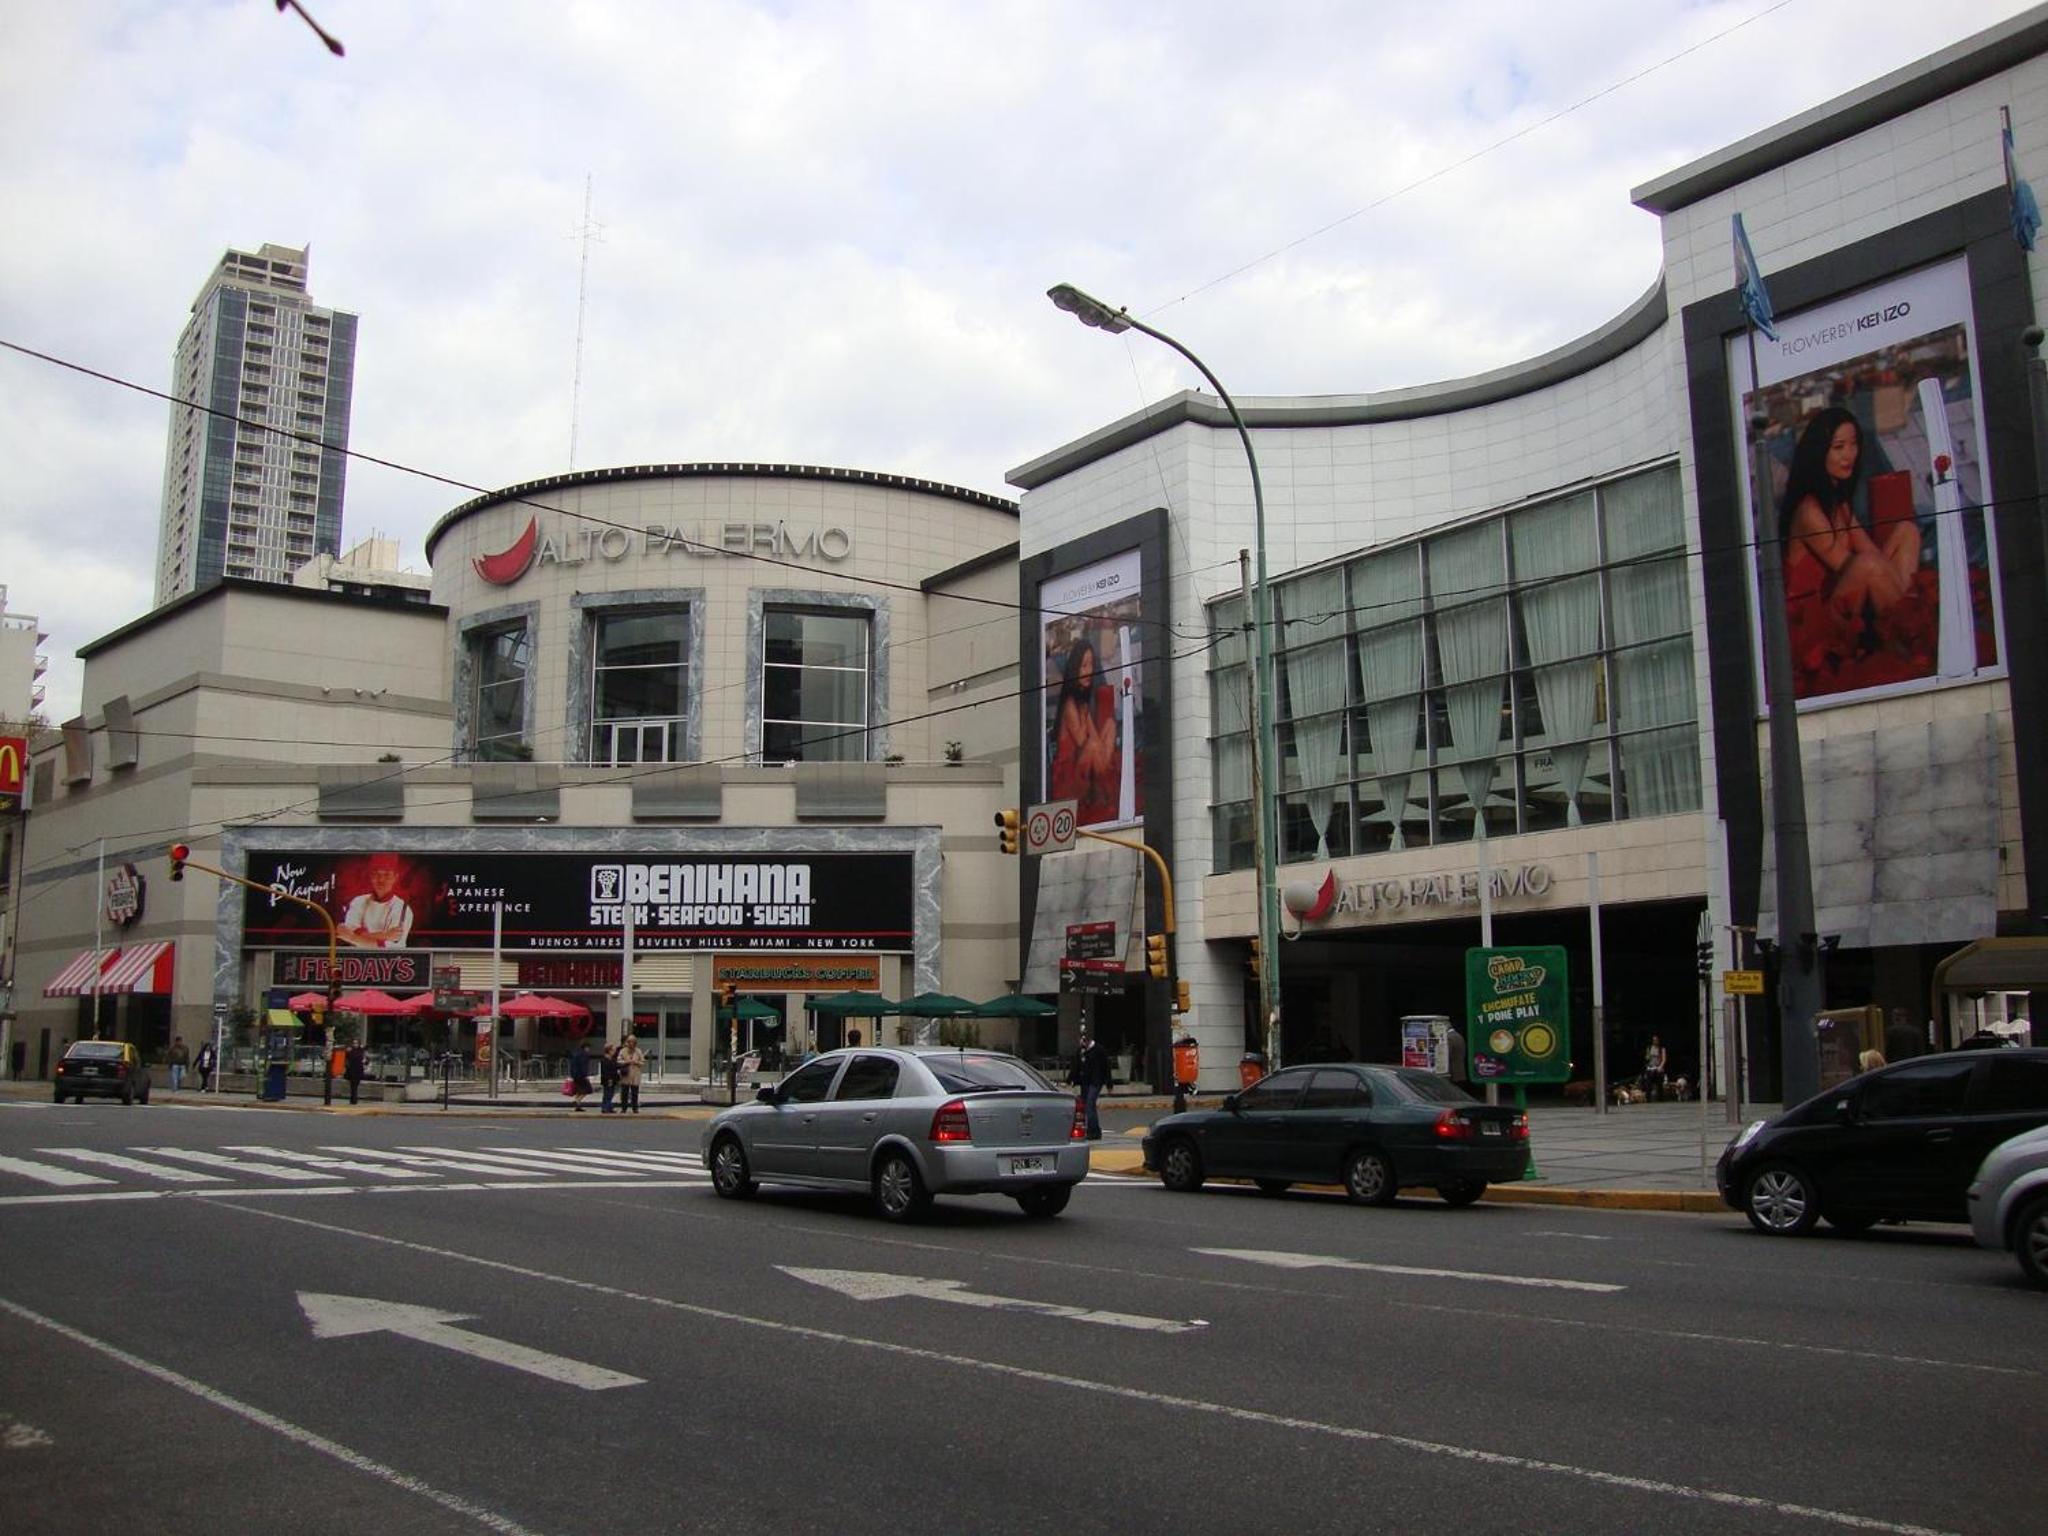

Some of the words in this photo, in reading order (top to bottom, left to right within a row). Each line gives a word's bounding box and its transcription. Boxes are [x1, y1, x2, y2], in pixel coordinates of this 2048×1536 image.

[536, 526, 631, 568] ALTO
[645, 523, 851, 560] PALERMO
[1057, 816, 1070, 834] 20
[277, 863, 306, 882] Now
[455, 874, 477, 883] THE
[625, 864, 811, 904] BENIHANA
[1336, 880, 1403, 914] ALTO
[447, 899, 532, 915] EXPERINCE
[658, 905, 744, 926] SEAFOOD
[752, 905, 811, 926] SUSHI
[530, 937, 580, 948] BUENOS
[586, 937, 622, 948] AIRES
[638, 938, 691, 948] BEVERLY
[699, 938, 733, 948] HILLS
[748, 938, 791, 948] MIAMI
[807, 938, 837, 948] NEW
[841, 939, 876, 948] YORK
[299, 955, 415, 983] FRDAY'S
[719, 967, 812, 980] STARBUCKS
[816, 967, 874, 980] COFFEE
[1477, 1014, 1484, 1024] Y
[1488, 1009, 1513, 1023] PONE
[1516, 1004, 1540, 1018] PLAY
